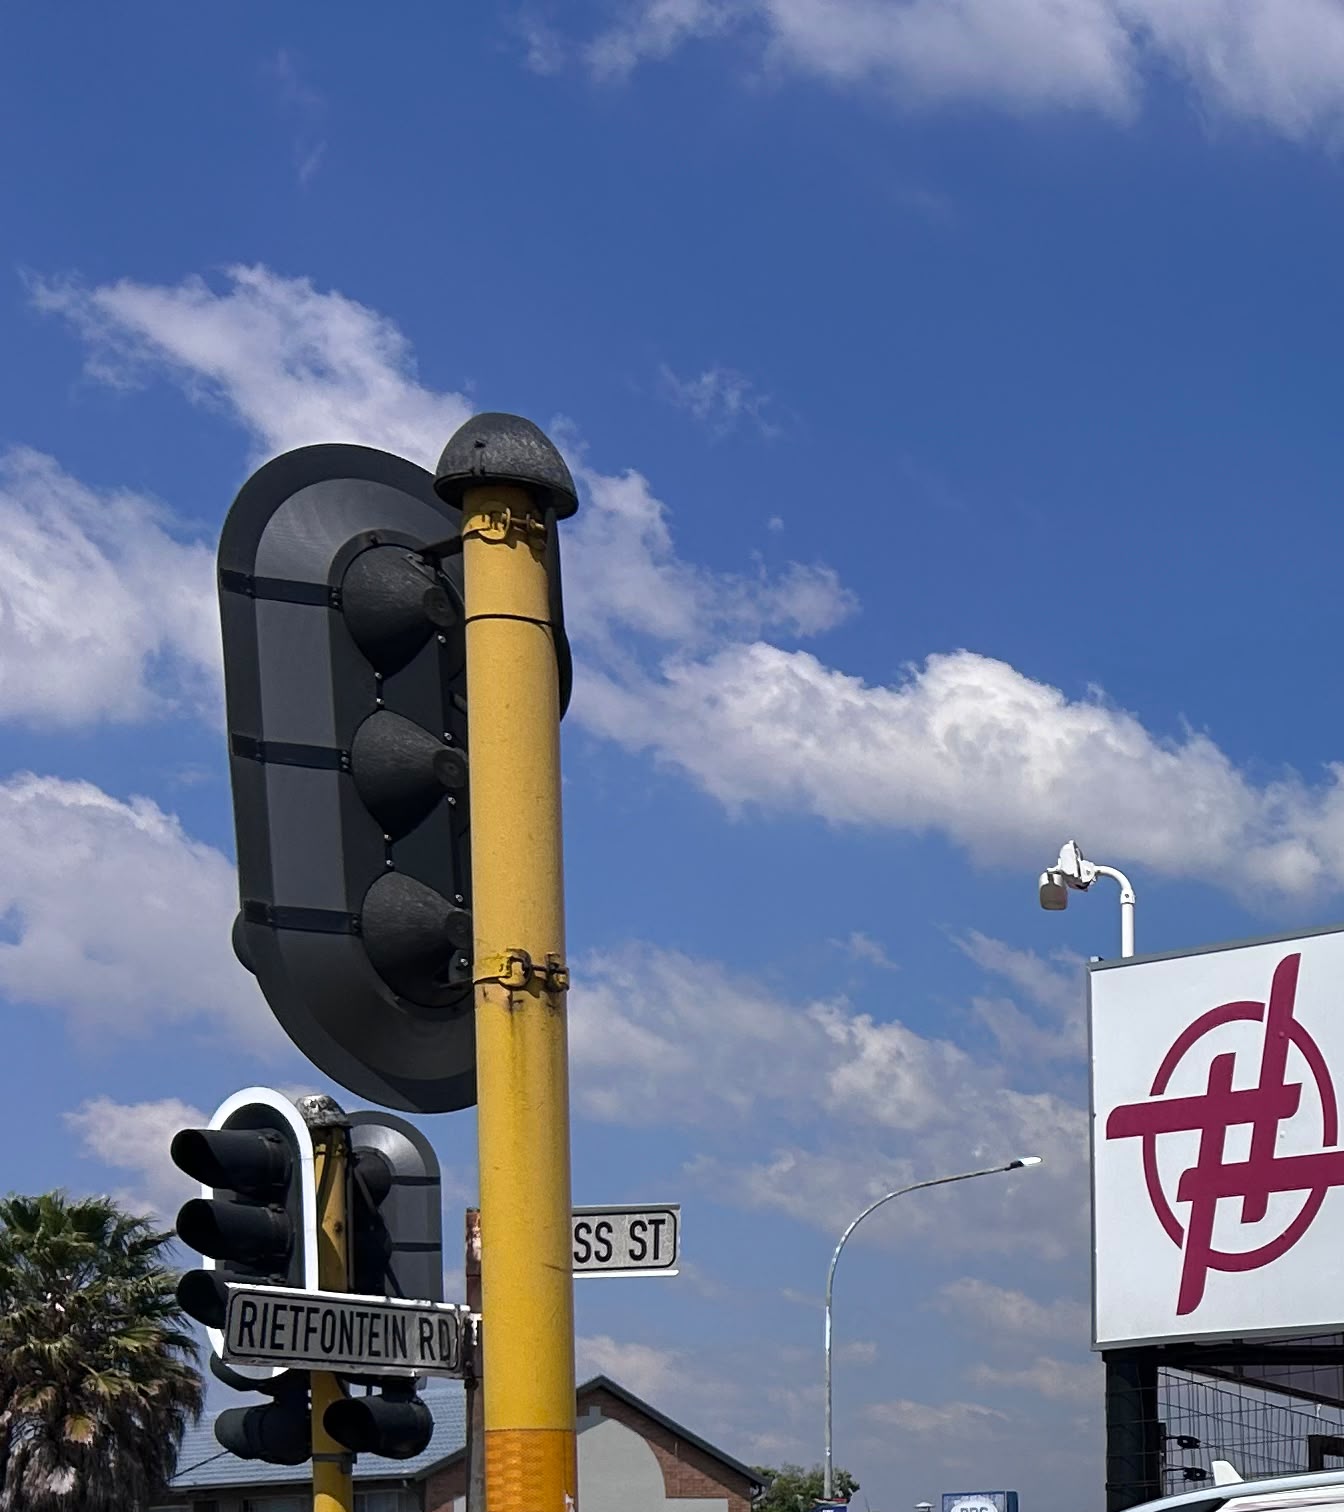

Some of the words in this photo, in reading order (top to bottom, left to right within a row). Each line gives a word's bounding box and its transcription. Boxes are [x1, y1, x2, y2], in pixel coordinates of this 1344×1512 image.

[629, 1218, 666, 1261] ST
[237, 1300, 407, 1359] RIETFONTEIN
[419, 1317, 451, 1362] RD
